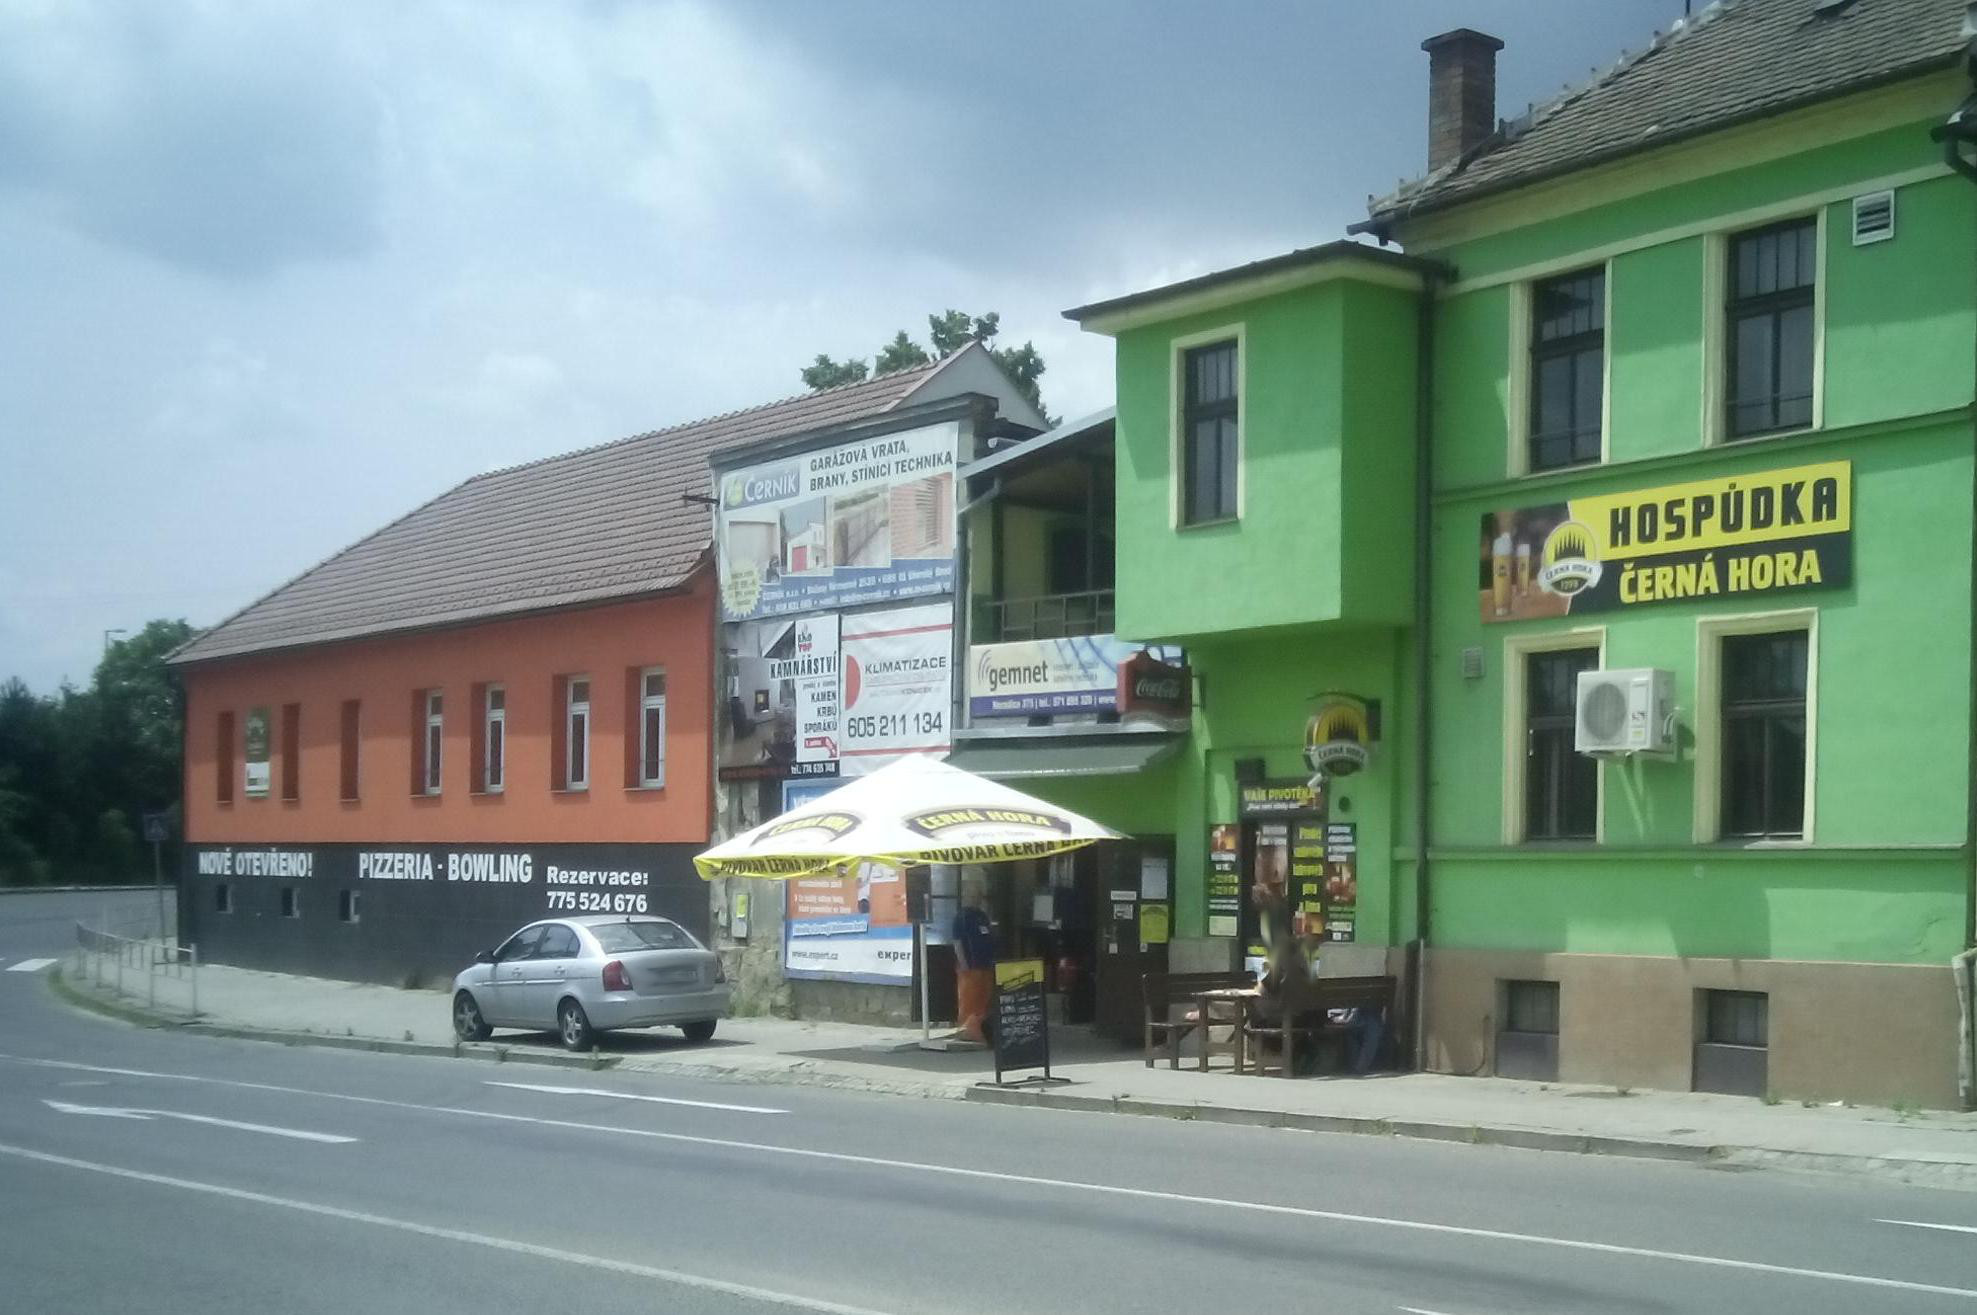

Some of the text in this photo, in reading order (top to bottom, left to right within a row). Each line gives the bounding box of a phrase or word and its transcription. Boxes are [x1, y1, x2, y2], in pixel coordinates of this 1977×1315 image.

[894, 451, 953, 475] TECHNIKA
[1609, 477, 1837, 549] HOSPŮDKA
[1619, 550, 1822, 603] ČERNÁ HORA
[770, 650, 837, 679] KAMNÁŘSTVÍ
[865, 656, 946, 674] KLIMATIZACE
[989, 661, 1048, 691] gemnet
[847, 712, 942, 738] 605 211 134
[985, 811, 1051, 827] HORA
[235, 847, 313, 877] OTEVŘENO!
[359, 852, 533, 883] PIZZERIA BOWLING
[546, 865, 649, 886] Rezervace:
[546, 891, 648, 912] 775 524 676
